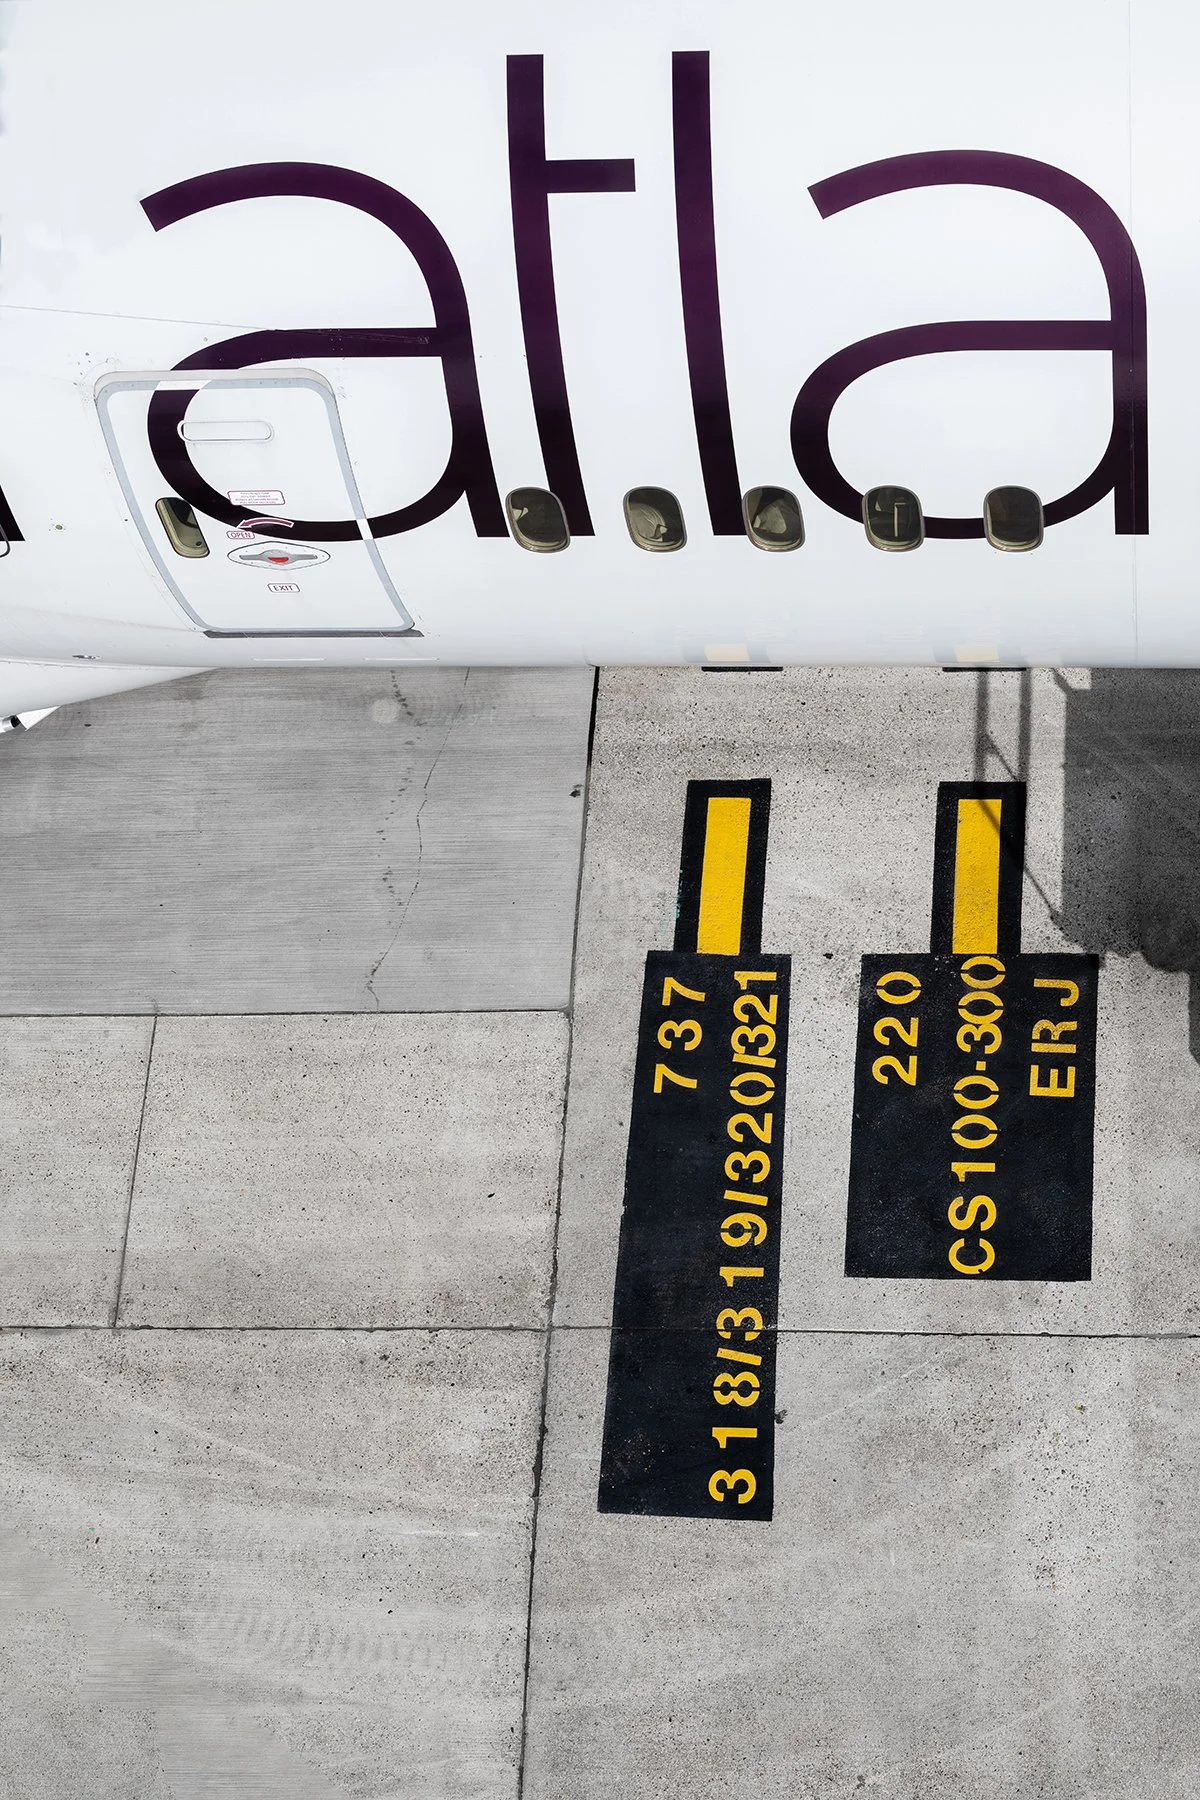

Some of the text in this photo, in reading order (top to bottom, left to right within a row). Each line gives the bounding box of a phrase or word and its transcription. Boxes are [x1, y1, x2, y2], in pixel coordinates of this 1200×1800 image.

[230, 531, 252, 539] OPEN
[653, 976, 706, 1093] 737
[872, 970, 921, 1086] 220
[1030, 978, 1080, 1098] ERJ
[709, 968, 777, 1504] 318/319/320/321
